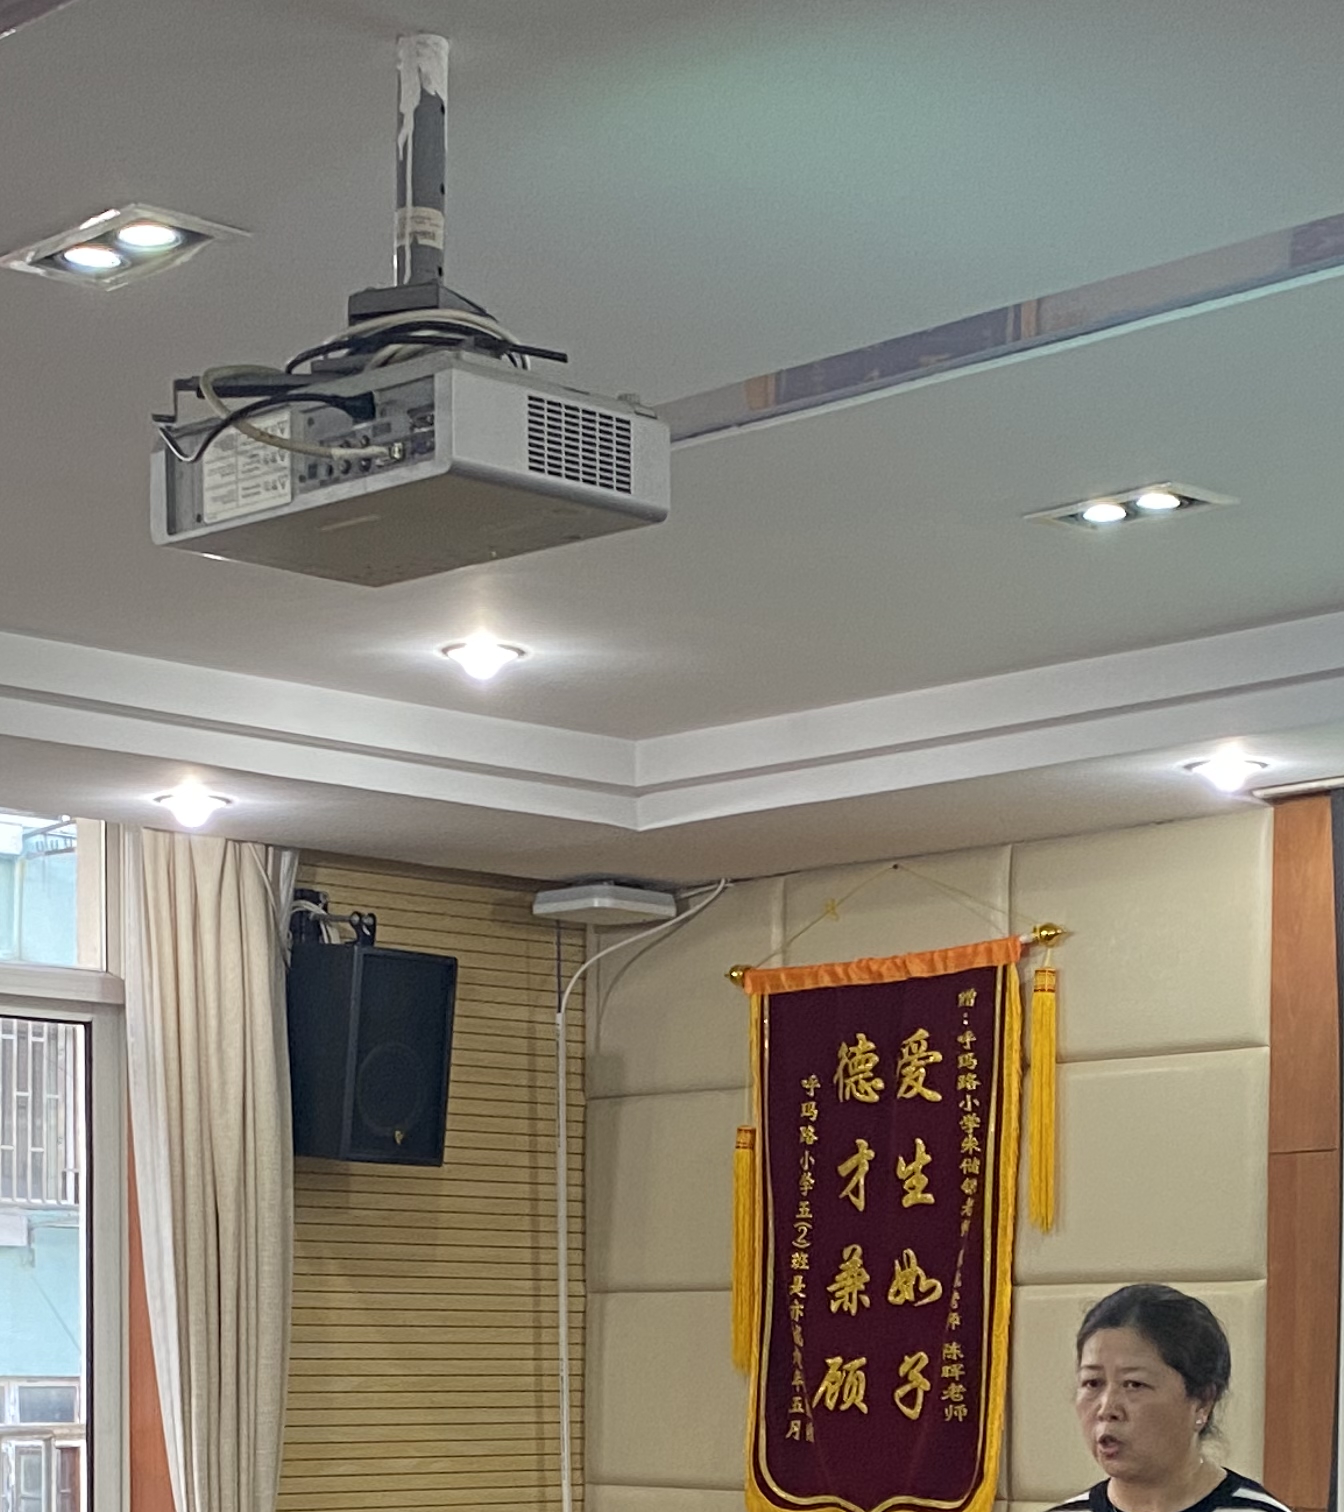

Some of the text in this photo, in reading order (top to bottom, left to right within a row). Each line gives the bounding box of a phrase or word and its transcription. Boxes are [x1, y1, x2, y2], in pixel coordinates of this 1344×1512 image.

[811, 1032, 886, 1416] 德才兼顾
[887, 1028, 944, 1421] 爱生如子
